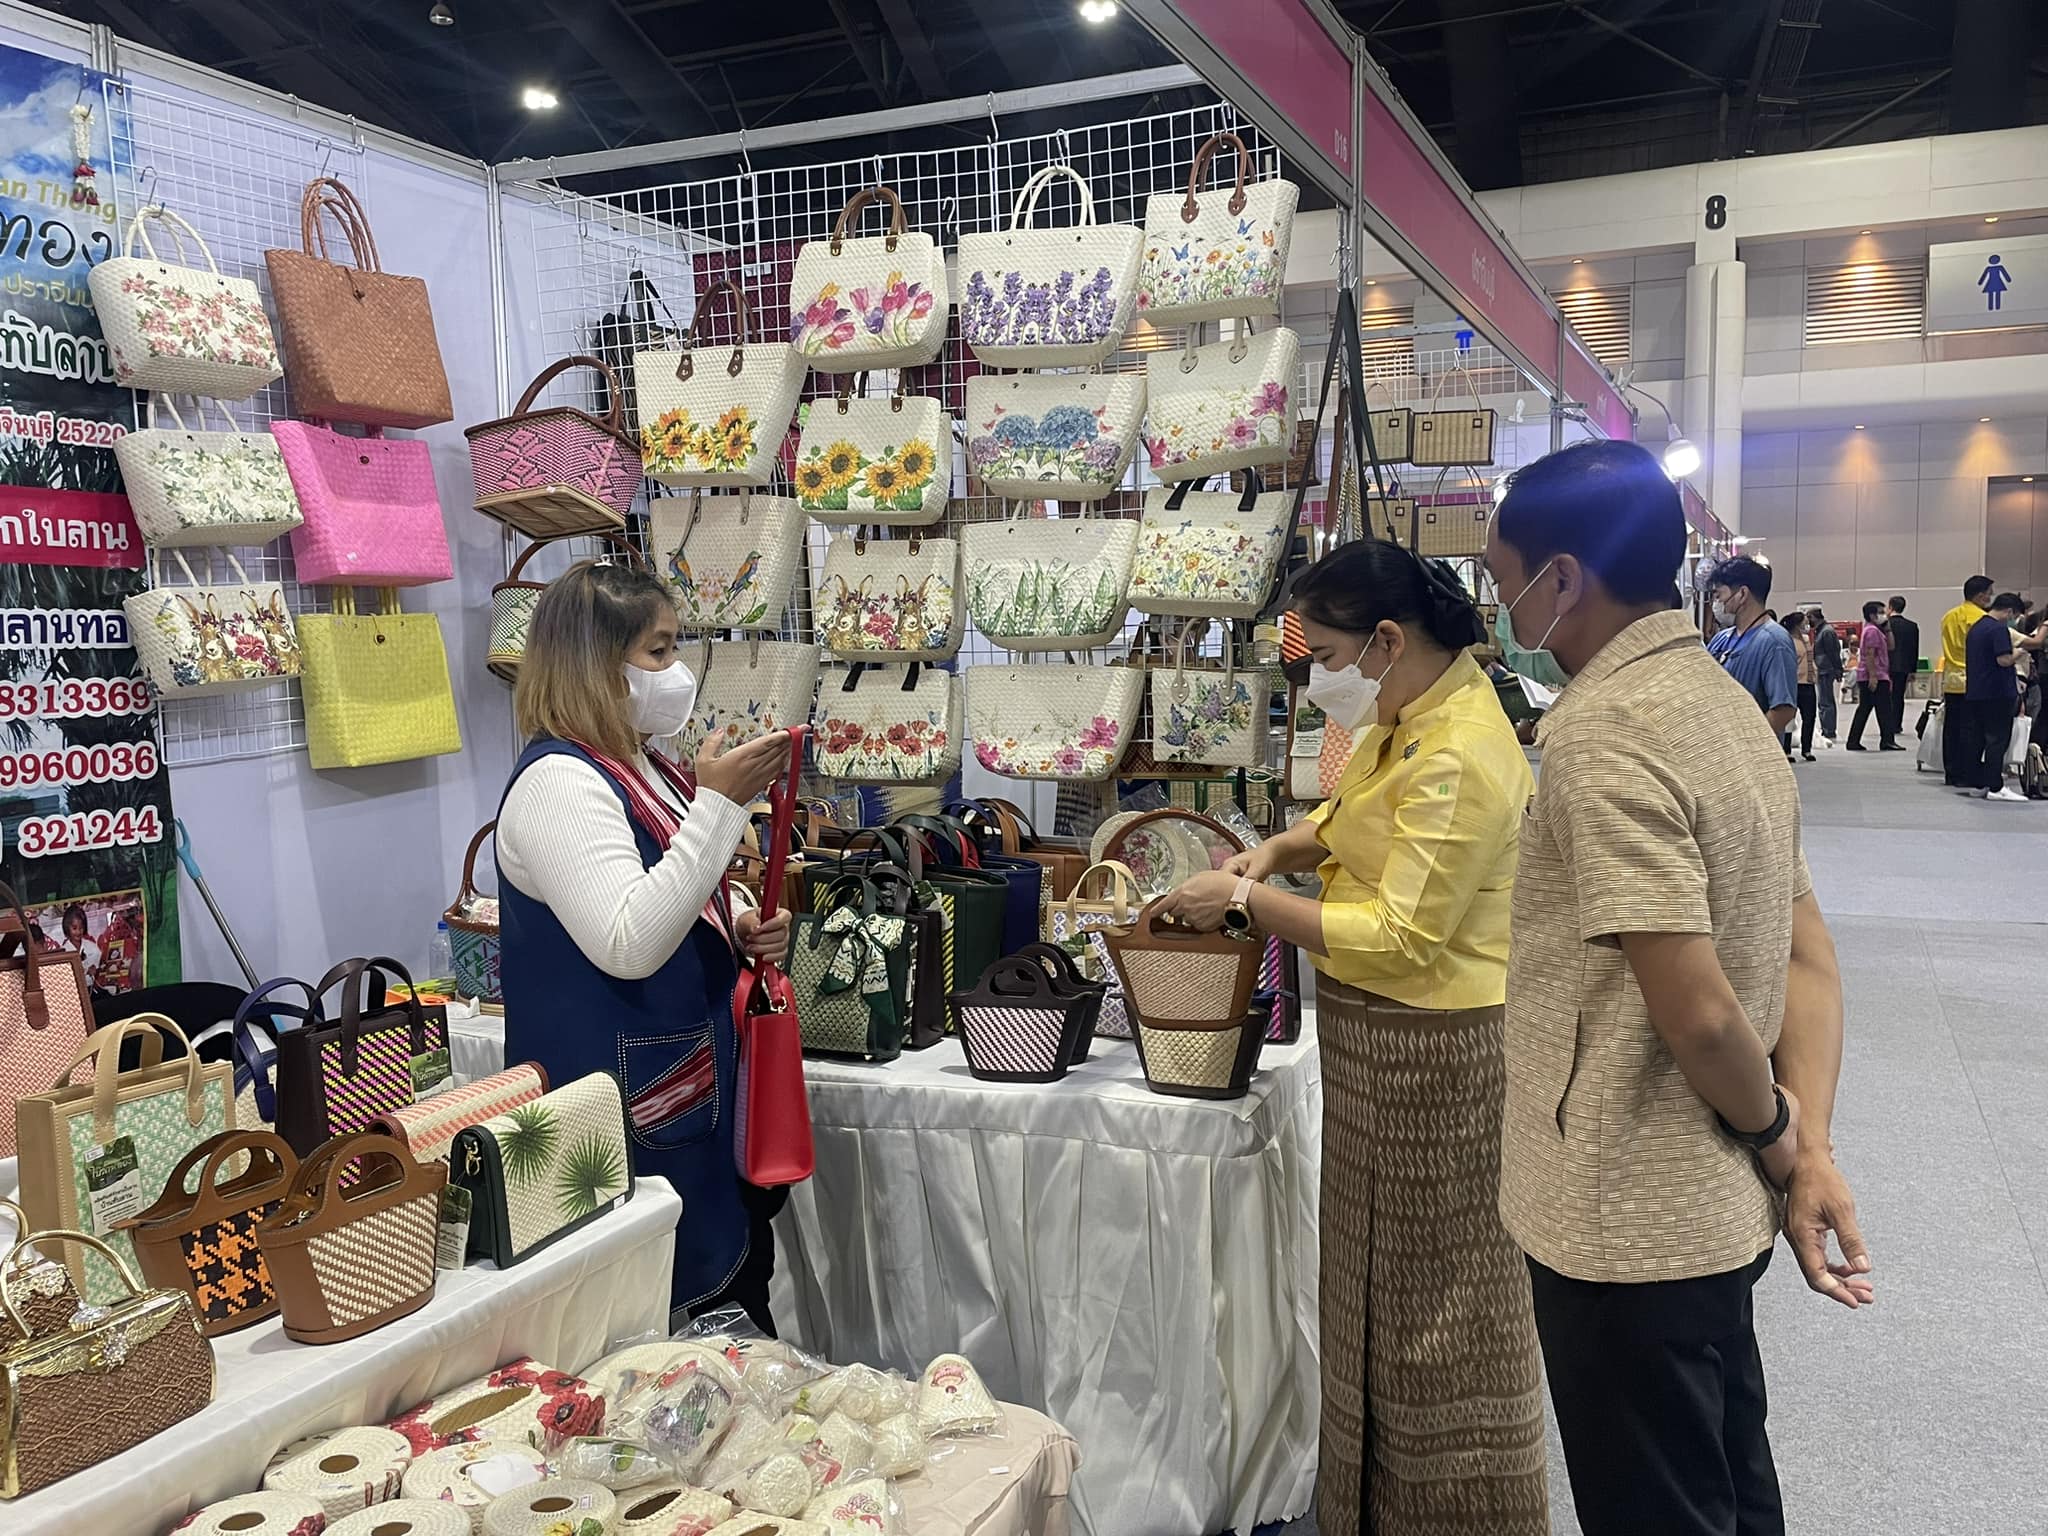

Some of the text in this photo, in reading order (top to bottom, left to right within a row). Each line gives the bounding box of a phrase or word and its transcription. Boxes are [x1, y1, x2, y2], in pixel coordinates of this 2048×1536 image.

[1705, 194, 1727, 231] 8
[0, 681, 150, 717] 8313369
[0, 746, 155, 787] 9960036
[23, 810, 159, 853] 321244
